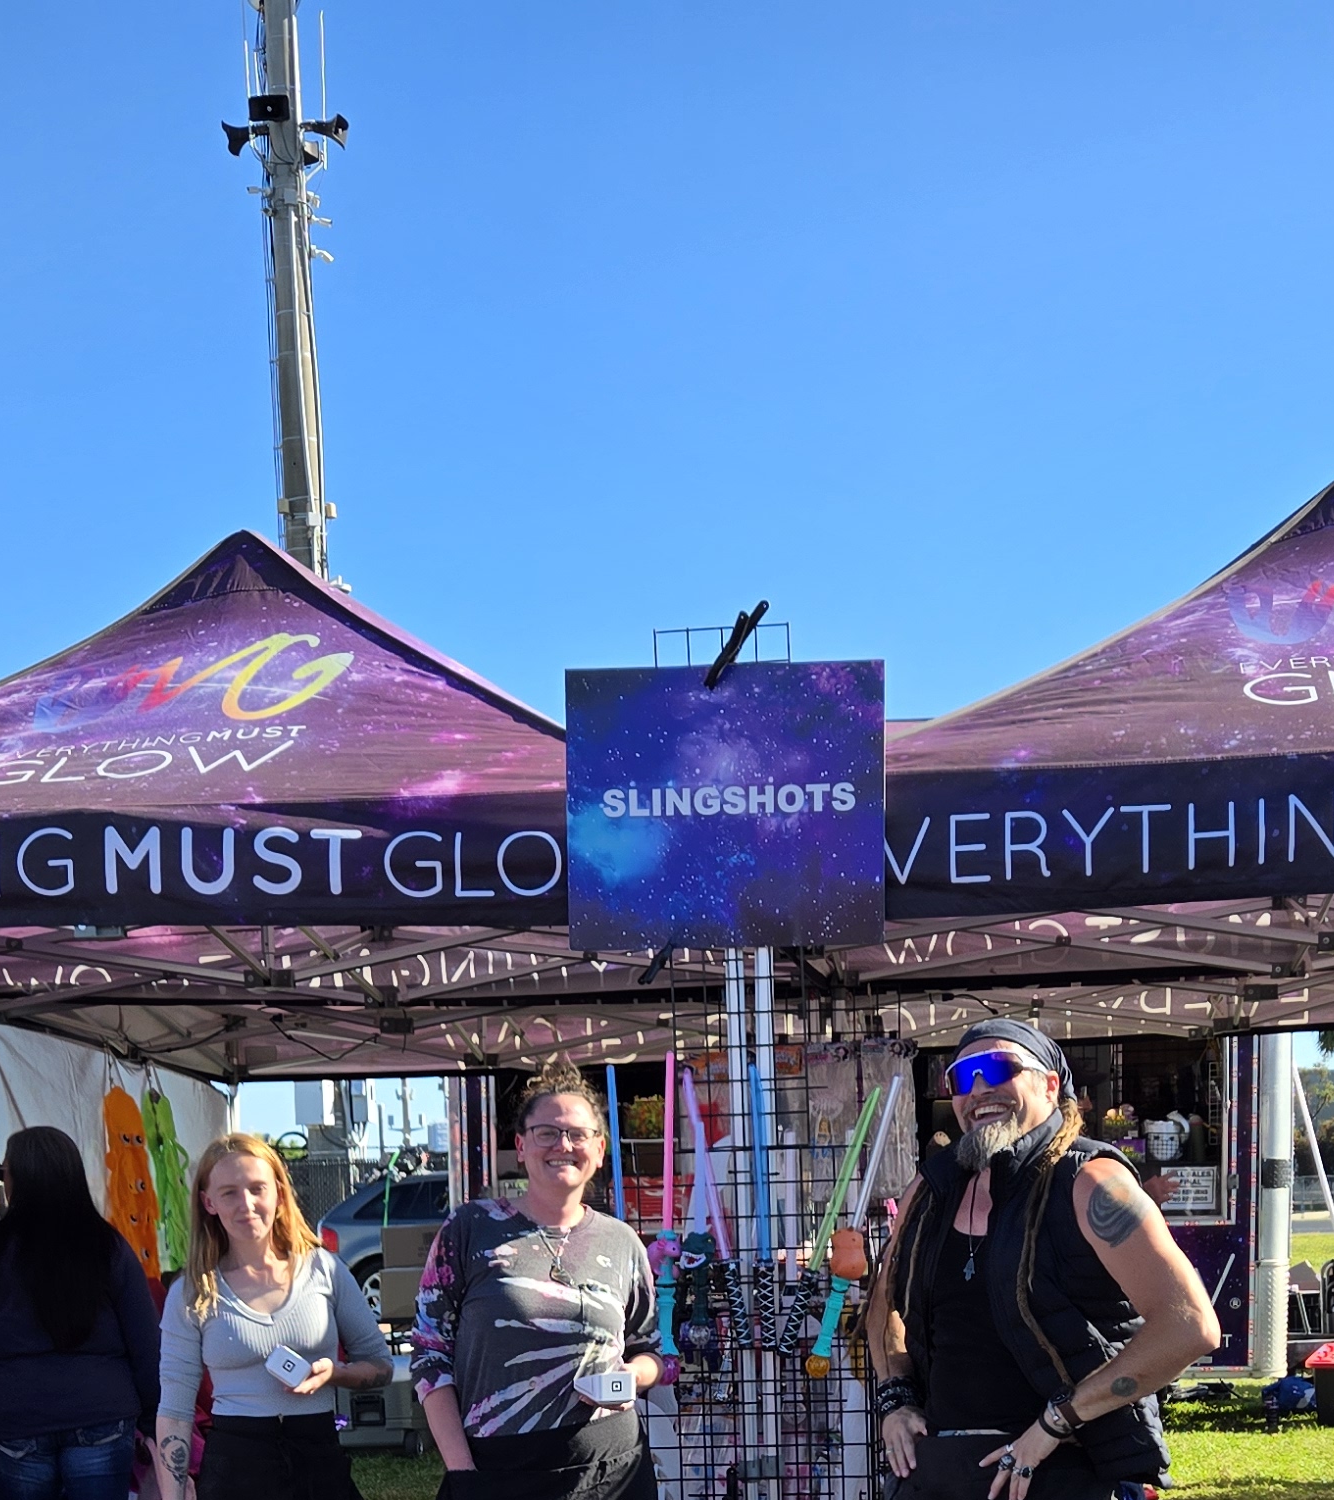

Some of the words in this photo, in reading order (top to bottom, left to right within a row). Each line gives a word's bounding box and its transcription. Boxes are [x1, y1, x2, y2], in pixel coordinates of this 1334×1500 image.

[0, 732, 202, 759] VERYTHING
[206, 725, 307, 743] MUST
[602, 781, 856, 818] SLINGSHOTS
[105, 826, 362, 895] MUST
[384, 830, 562, 898] GLO
